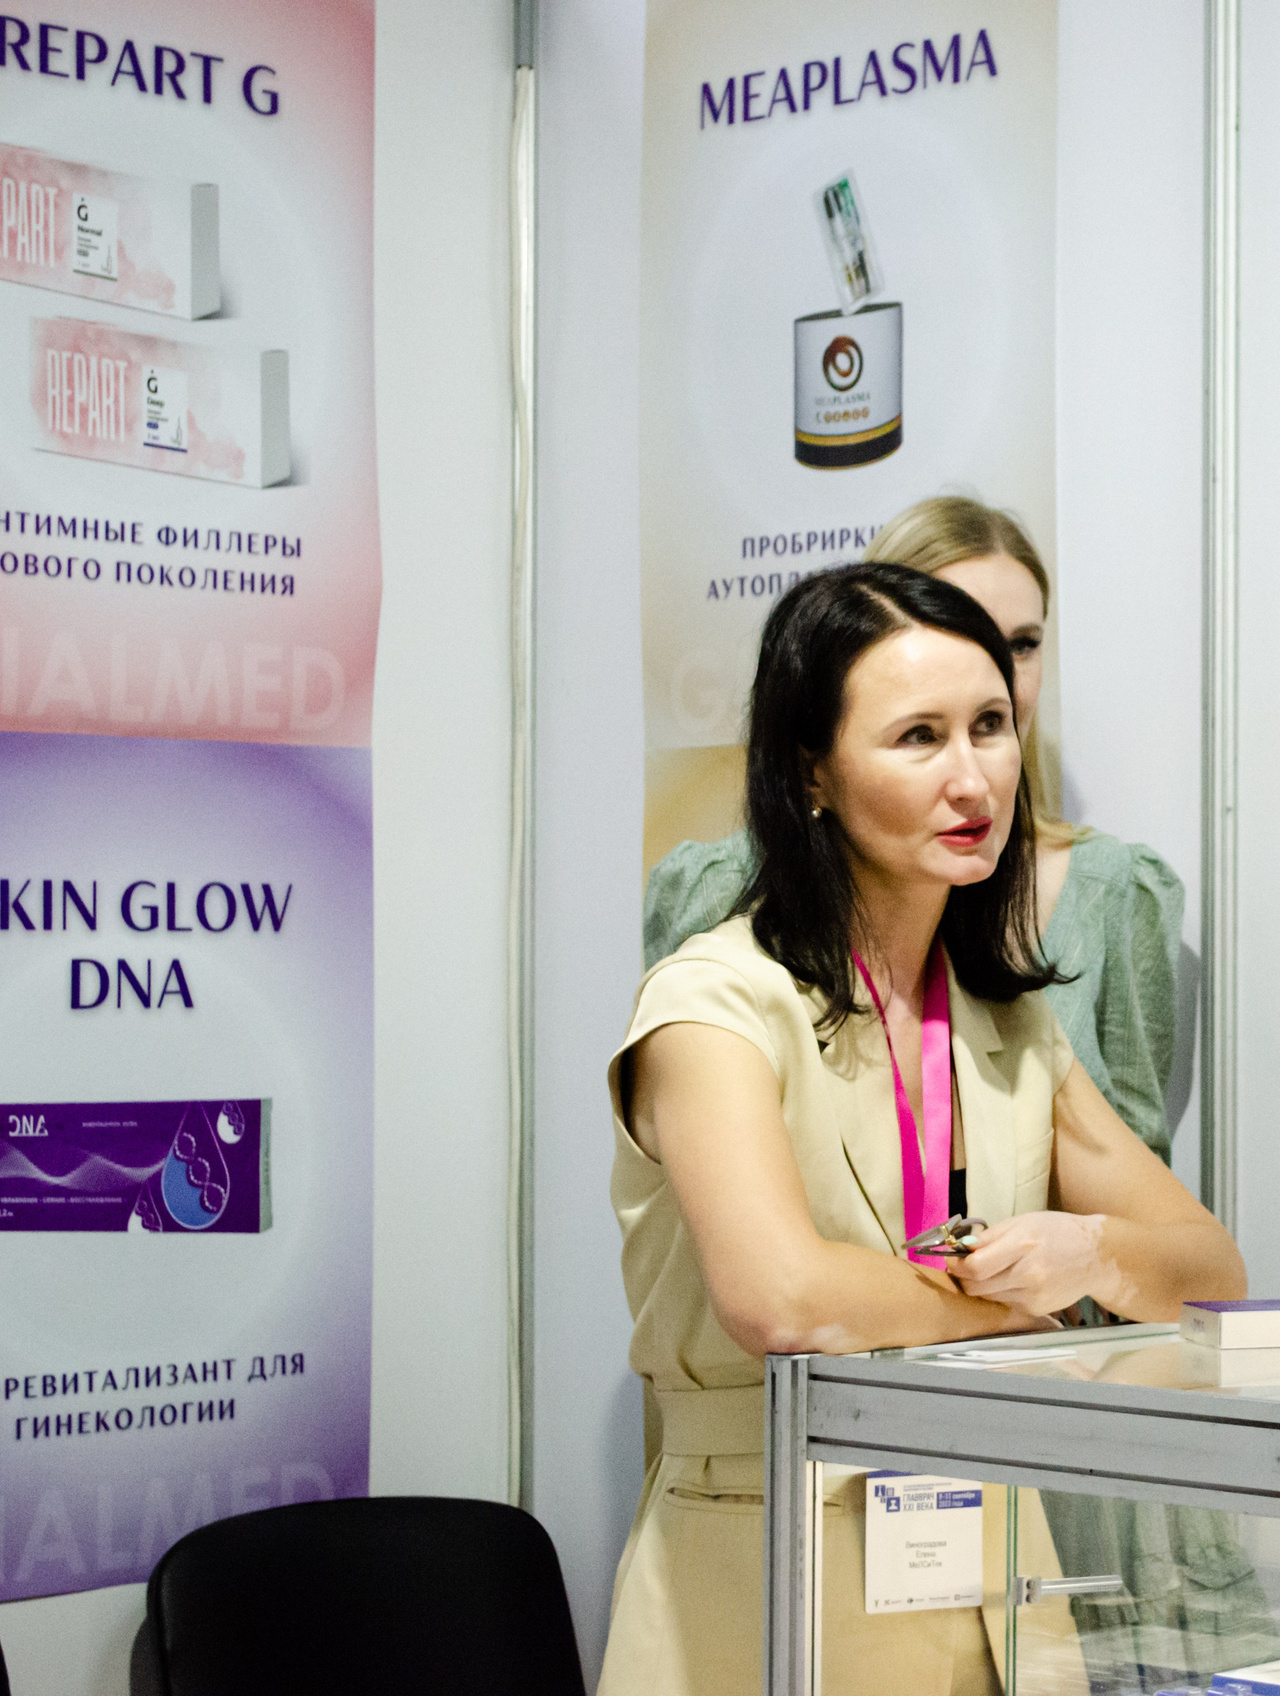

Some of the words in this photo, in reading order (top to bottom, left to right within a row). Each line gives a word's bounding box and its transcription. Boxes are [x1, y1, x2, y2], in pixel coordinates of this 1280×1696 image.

[0, 15, 225, 105] REPART
[241, 64, 281, 116] G
[700, 28, 999, 131] MEAPLASMA
[46, 349, 128, 442] REPART
[156, 525, 302, 558] ФИЛЛЕРЫ
[0, 551, 102, 581] ОВОГО
[115, 560, 297, 597] ПОКОЛЕНИЯ
[0, 878, 97, 931] KIN
[120, 880, 294, 933] GLOW
[70, 958, 195, 1010] DNA
[3, 1358, 237, 1401] РЕВИТАЛИЗАНТ
[247, 1352, 306, 1384] ДЛЯ
[15, 1398, 236, 1441] ГИНЕКОЛОГИИ
